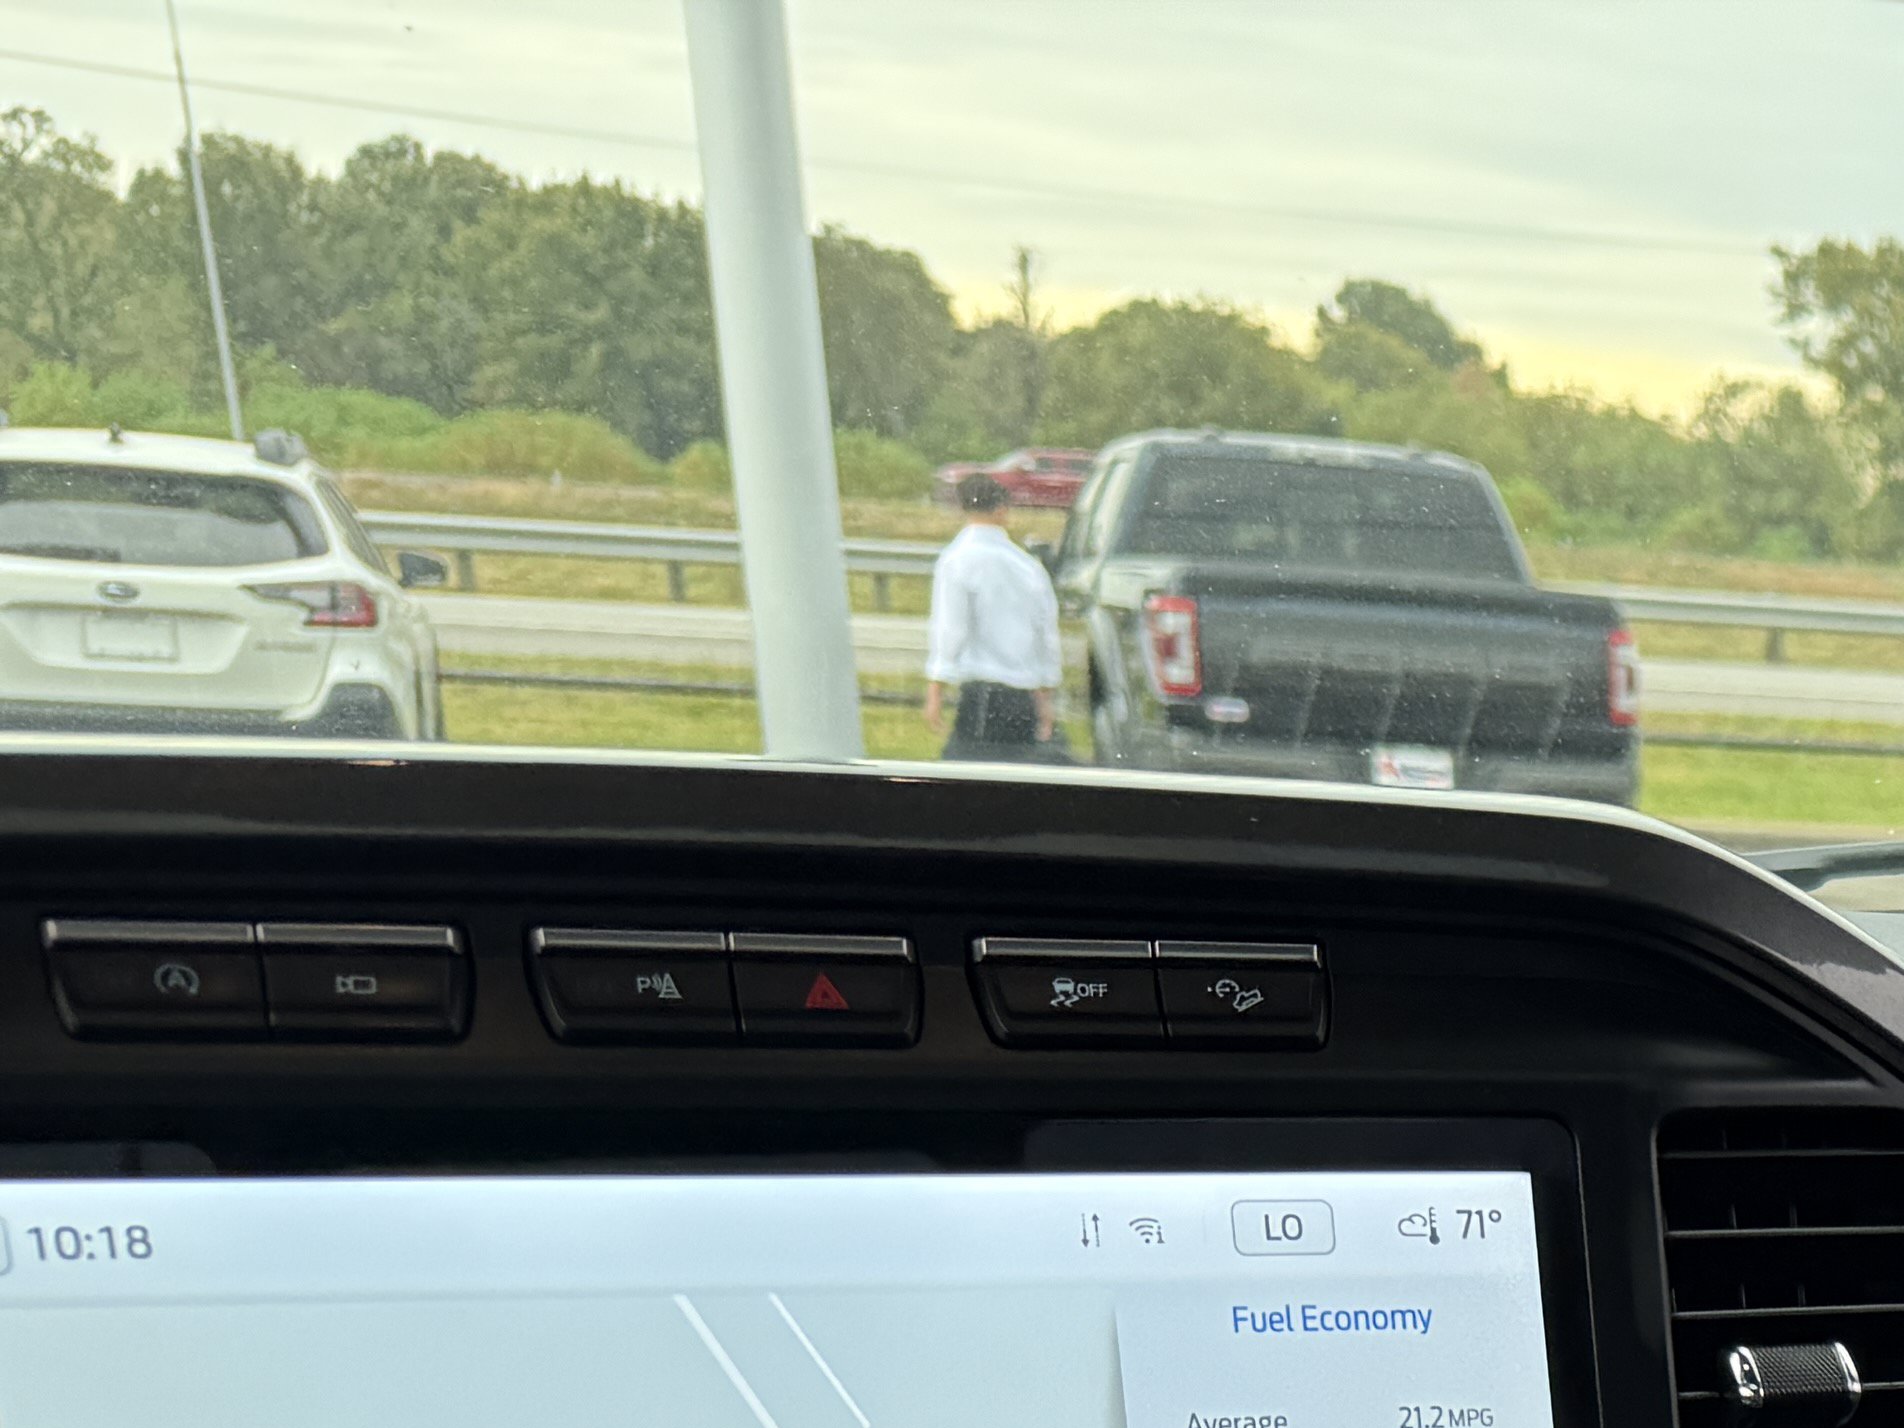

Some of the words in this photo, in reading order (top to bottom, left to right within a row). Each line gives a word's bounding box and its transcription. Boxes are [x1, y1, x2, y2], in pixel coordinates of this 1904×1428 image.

[1077, 981, 1108, 998] OFF
[1264, 1213, 1304, 1242] LO
[1455, 1209, 1502, 1240] 71°
[27, 1225, 153, 1261] 10:18
[1232, 1304, 1294, 1333] Fuel
[1300, 1304, 1432, 1334] Economy
[1449, 1407, 1494, 1428] MPG
